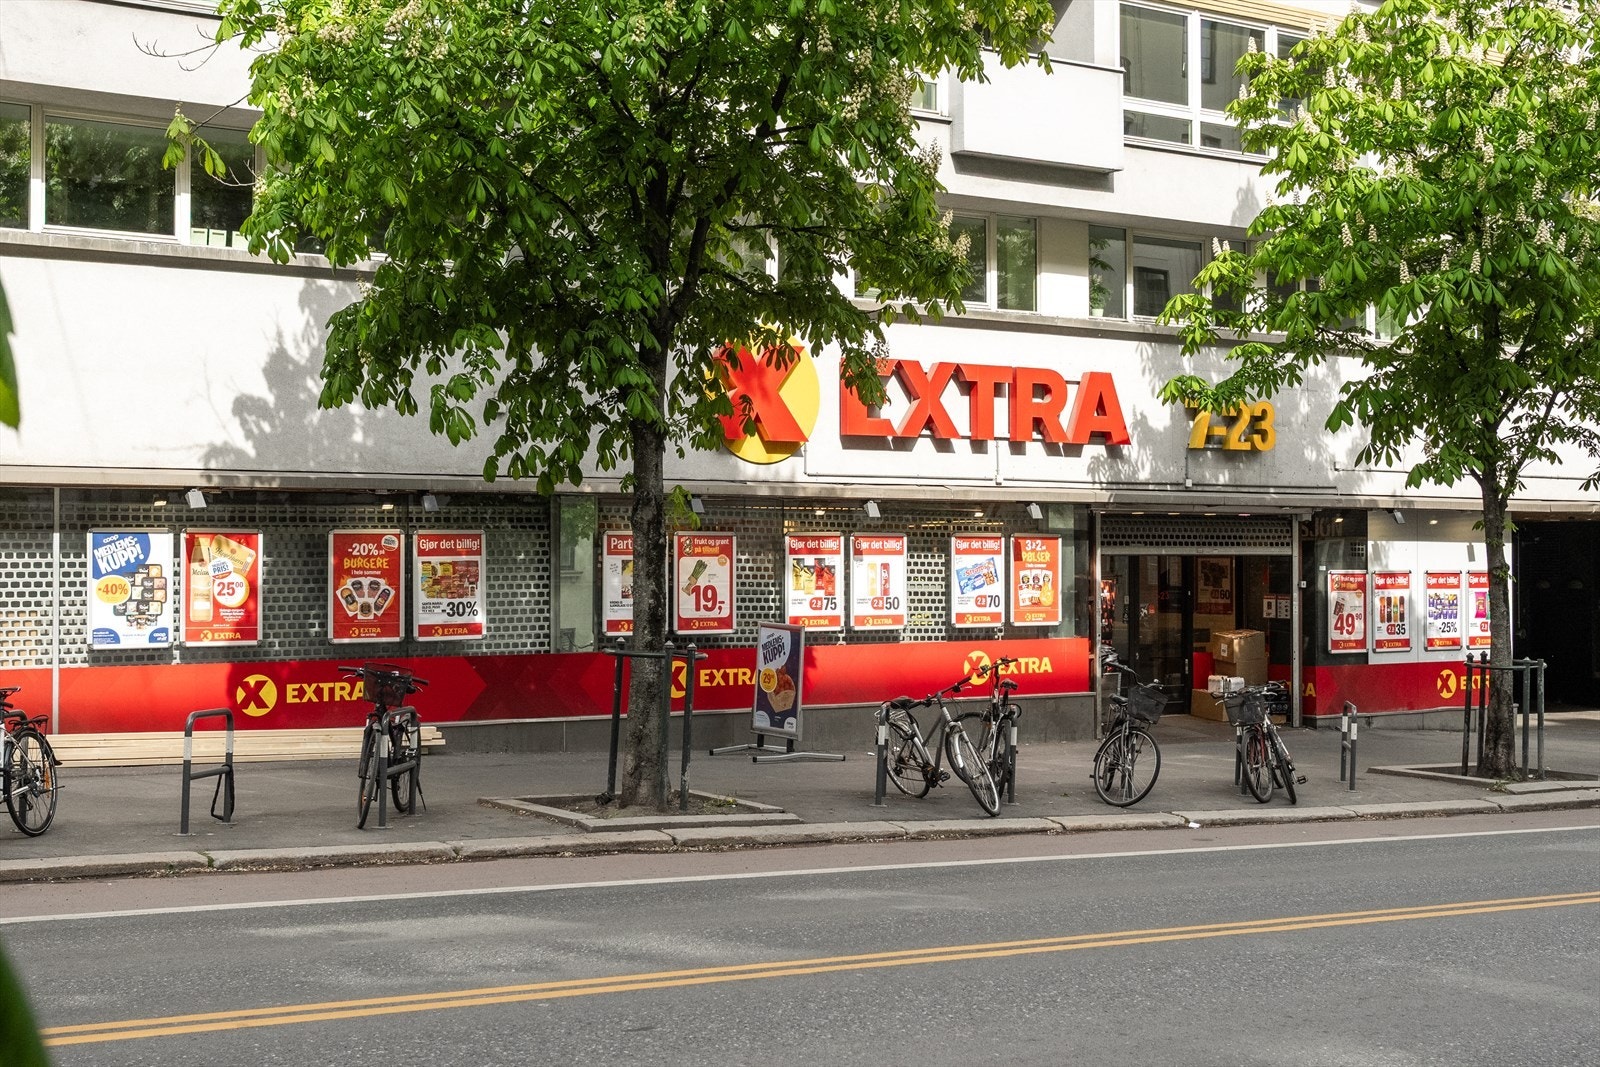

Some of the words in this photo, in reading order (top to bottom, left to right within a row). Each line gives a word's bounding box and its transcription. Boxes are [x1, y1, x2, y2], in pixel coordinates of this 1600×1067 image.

[840, 358, 1131, 445] EXTRA
[1185, 397, 1276, 451] 7-23
[348, 543, 379, 556] -20%
[420, 539, 439, 551] Gjør
[440, 539, 455, 549] det
[456, 539, 481, 551] billig!
[611, 537, 634, 549] Part
[790, 539, 806, 550] Gjør
[806, 539, 819, 549] det
[820, 539, 840, 551] billig!
[855, 540, 870, 550] Gjør
[871, 540, 883, 549] det
[884, 539, 903, 550] billig!
[956, 540, 970, 550] Gjør
[970, 540, 982, 549] det
[98, 543, 145, 575] KUPP!
[343, 556, 390, 569] BURGERE
[98, 584, 129, 595] -40%
[823, 597, 837, 610] 75
[885, 597, 900, 610] 50
[988, 595, 1001, 608] 70
[441, 601, 479, 617] -30%
[1396, 624, 1406, 635] 35
[1439, 622, 1458, 633] -25%
[214, 632, 241, 640] EXTRA
[763, 642, 786, 665] KUPP!
[997, 657, 1052, 675] EXTRA
[286, 682, 364, 703] EXTRA
